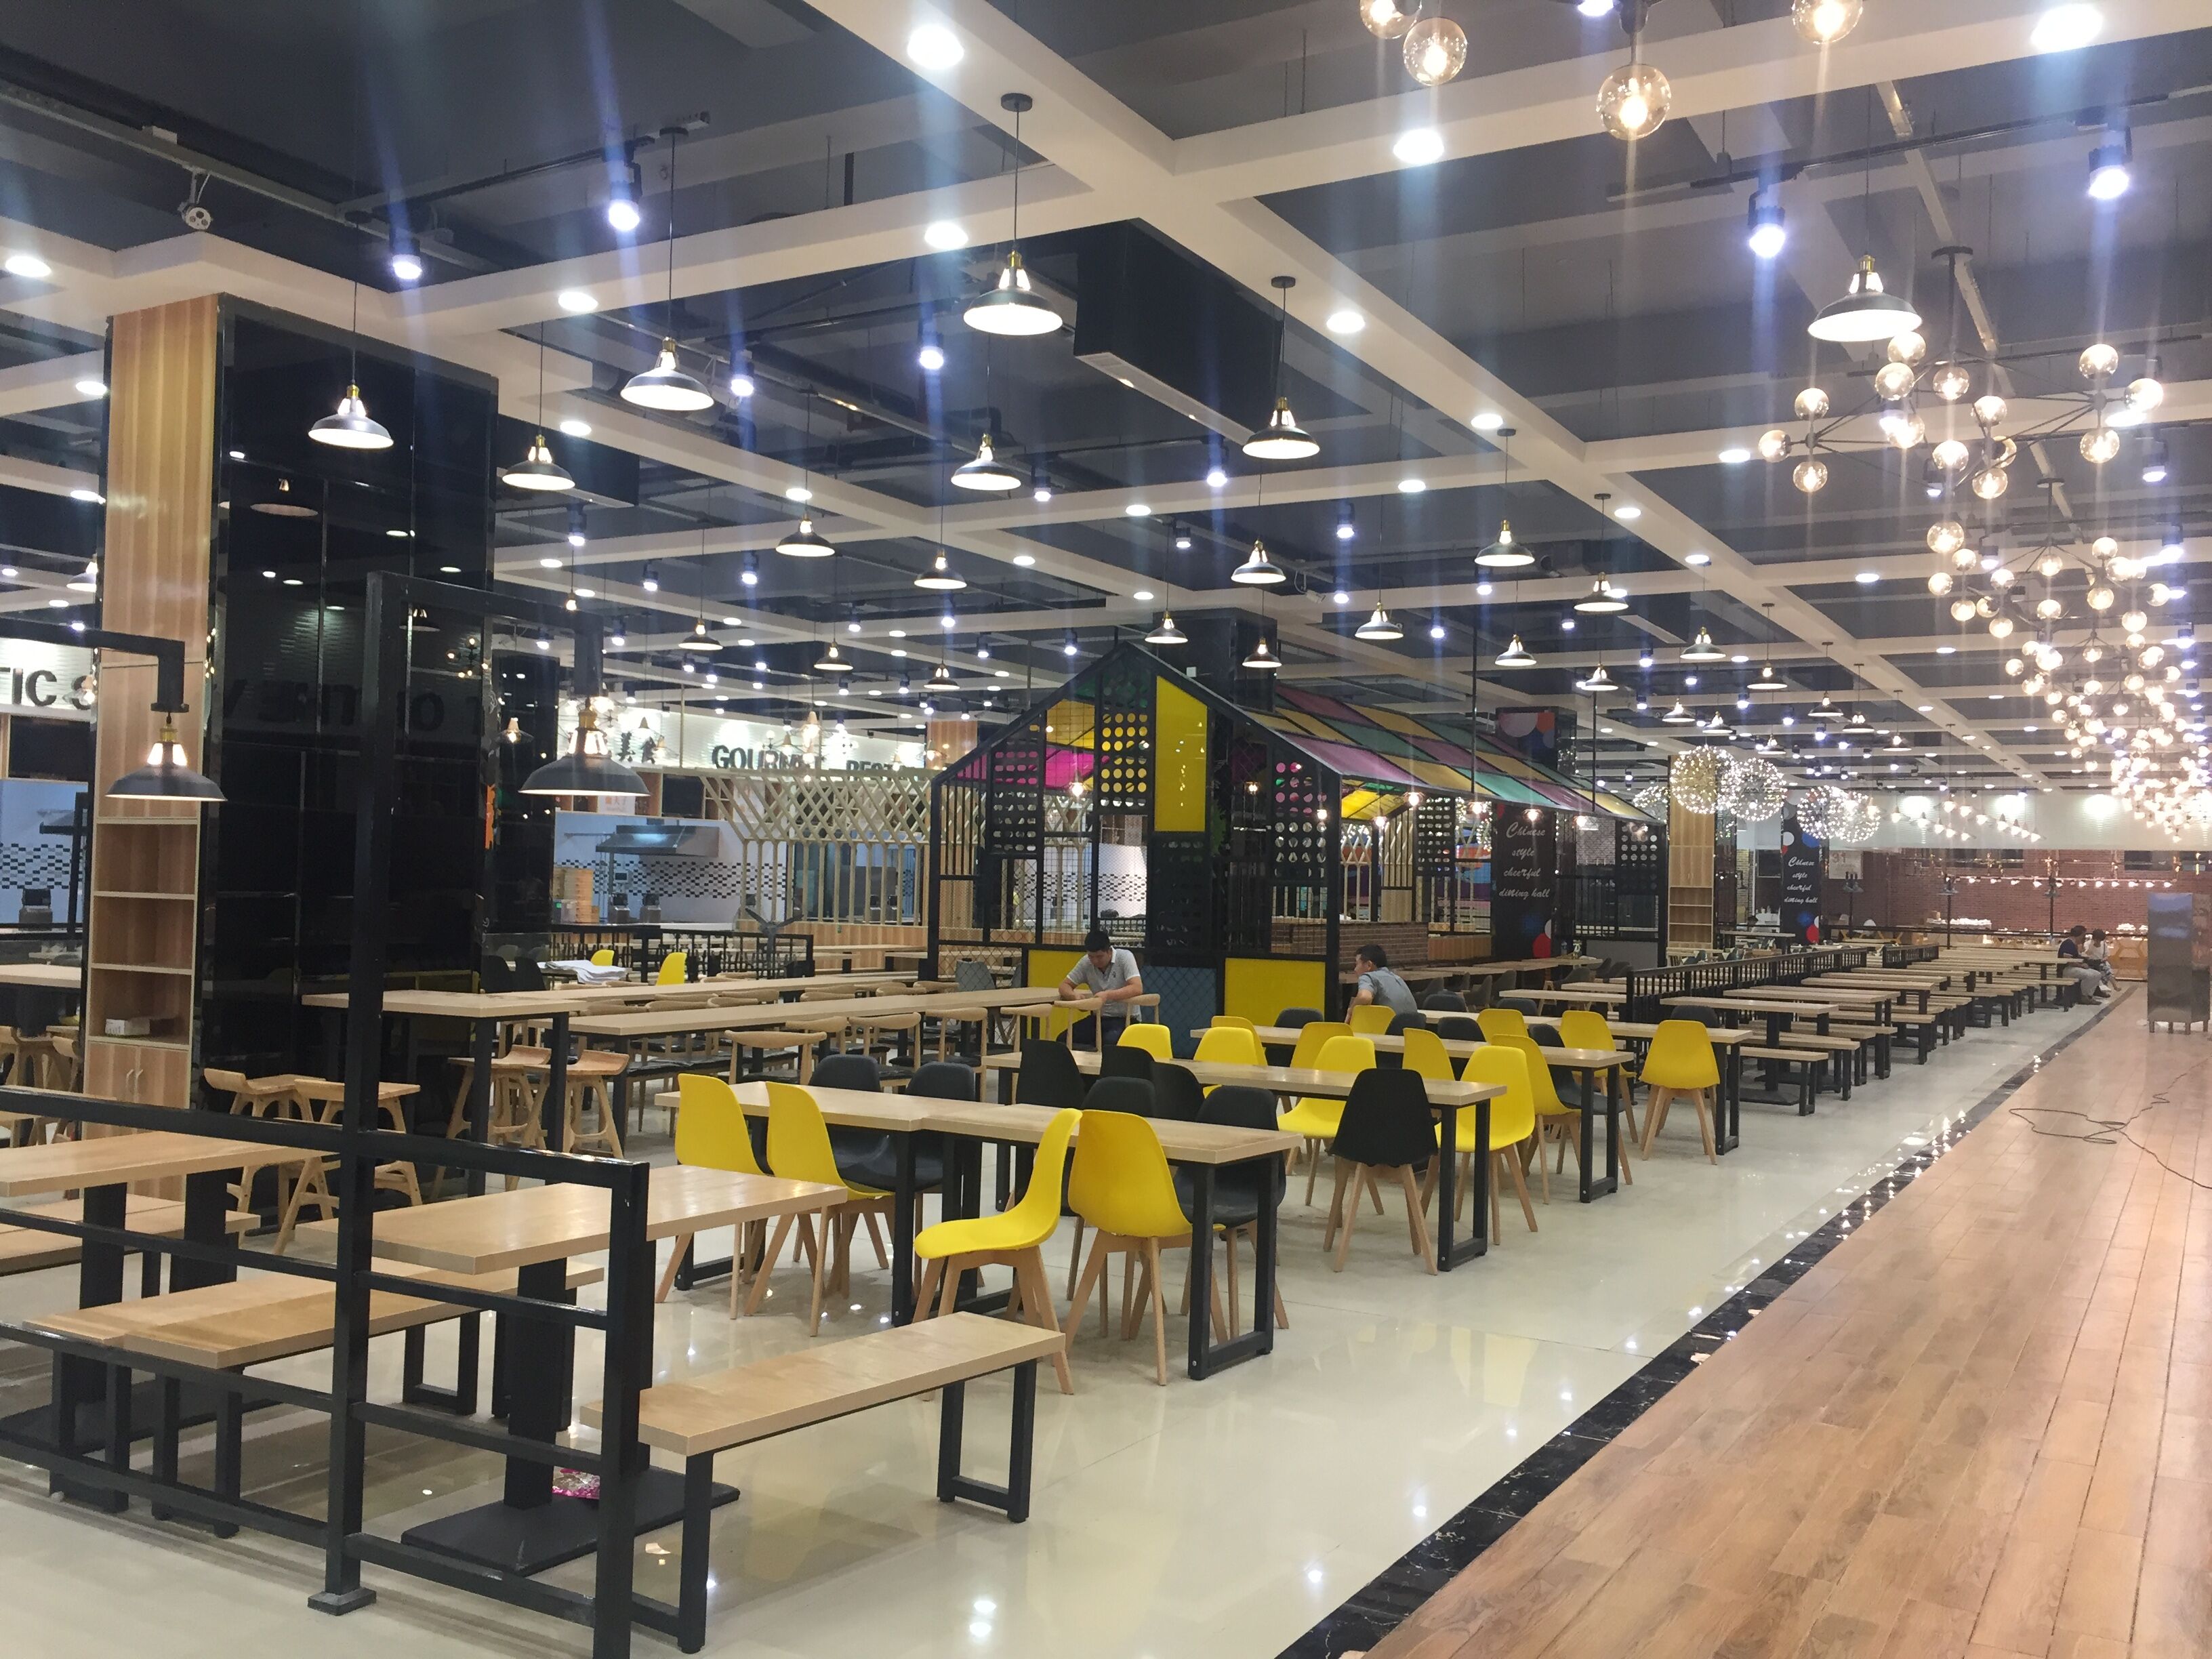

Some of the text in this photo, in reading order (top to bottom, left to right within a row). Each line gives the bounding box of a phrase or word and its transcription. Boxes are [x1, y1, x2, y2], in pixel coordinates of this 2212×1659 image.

[1506, 821, 1546, 838] Chinese
[1511, 847, 1535, 860] style
[1503, 867, 1541, 880] cheerful
[1498, 888, 1551, 900] dining hall
